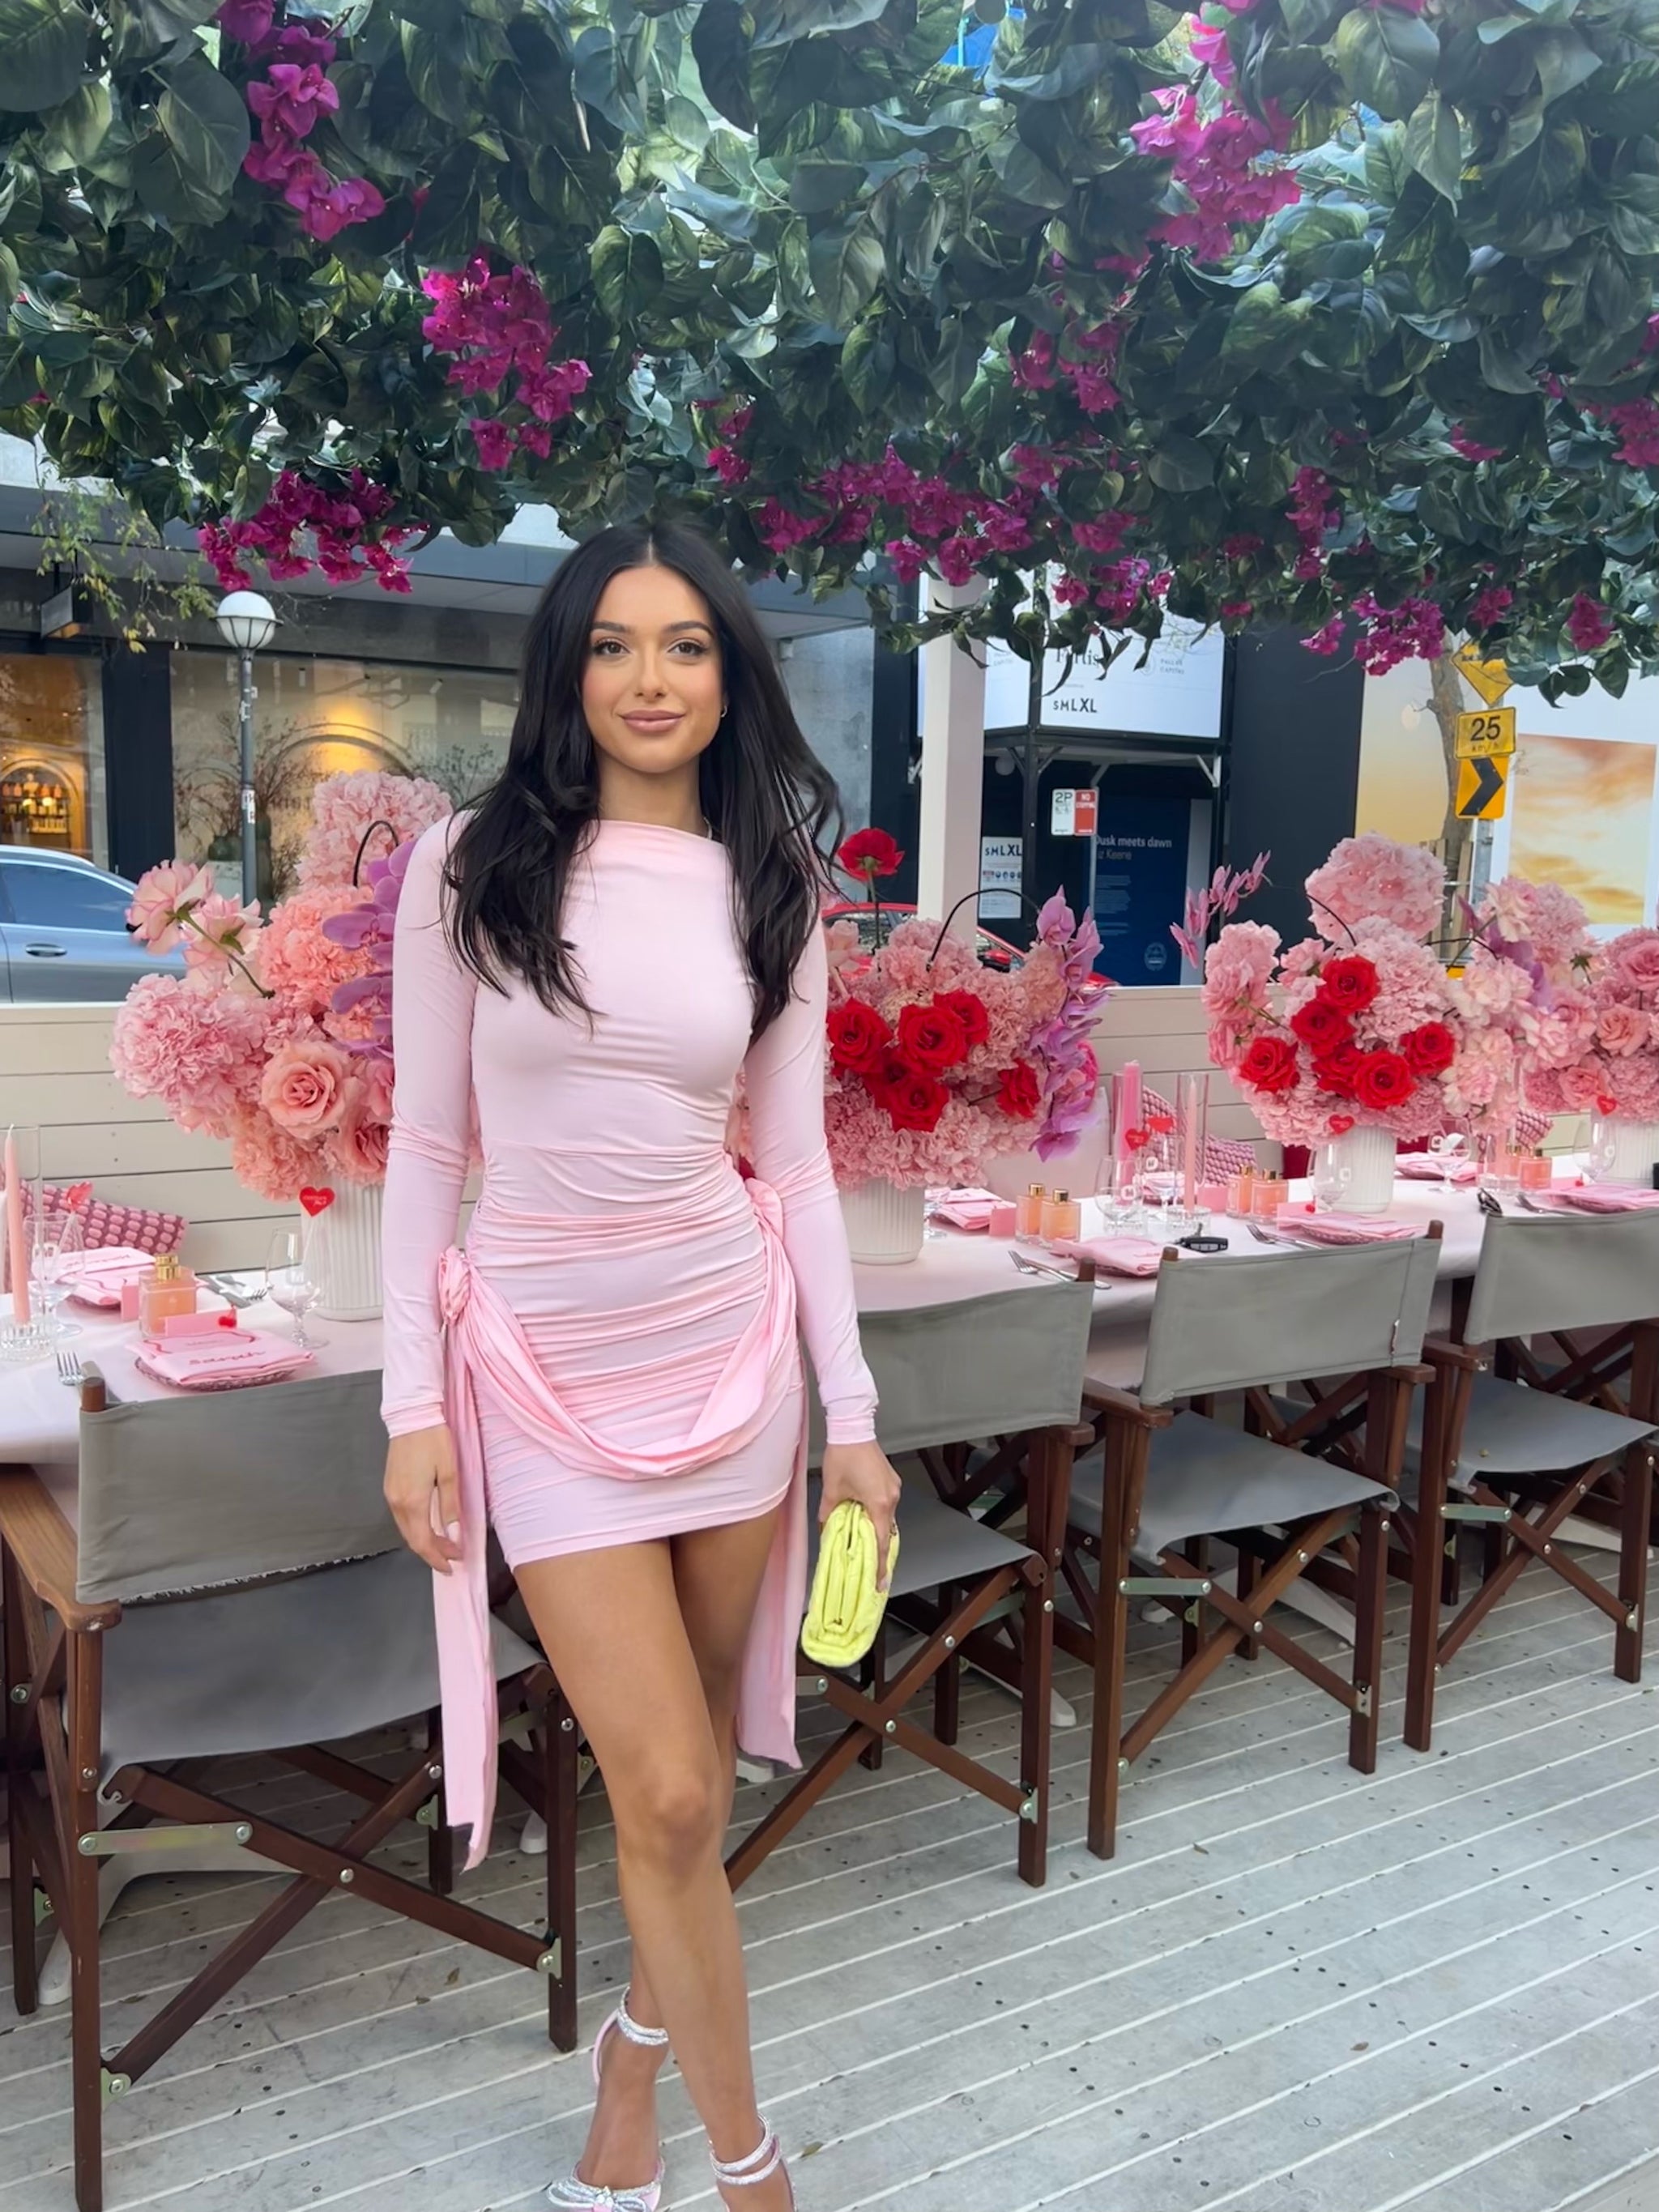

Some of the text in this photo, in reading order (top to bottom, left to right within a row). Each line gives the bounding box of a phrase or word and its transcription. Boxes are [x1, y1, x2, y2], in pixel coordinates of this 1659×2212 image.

[1053, 697, 1097, 713] SMLXL
[1470, 715, 1500, 741] 25
[1056, 791, 1073, 803] 2P
[1118, 837, 1145, 847] meets
[1147, 836, 1172, 848] dawn
